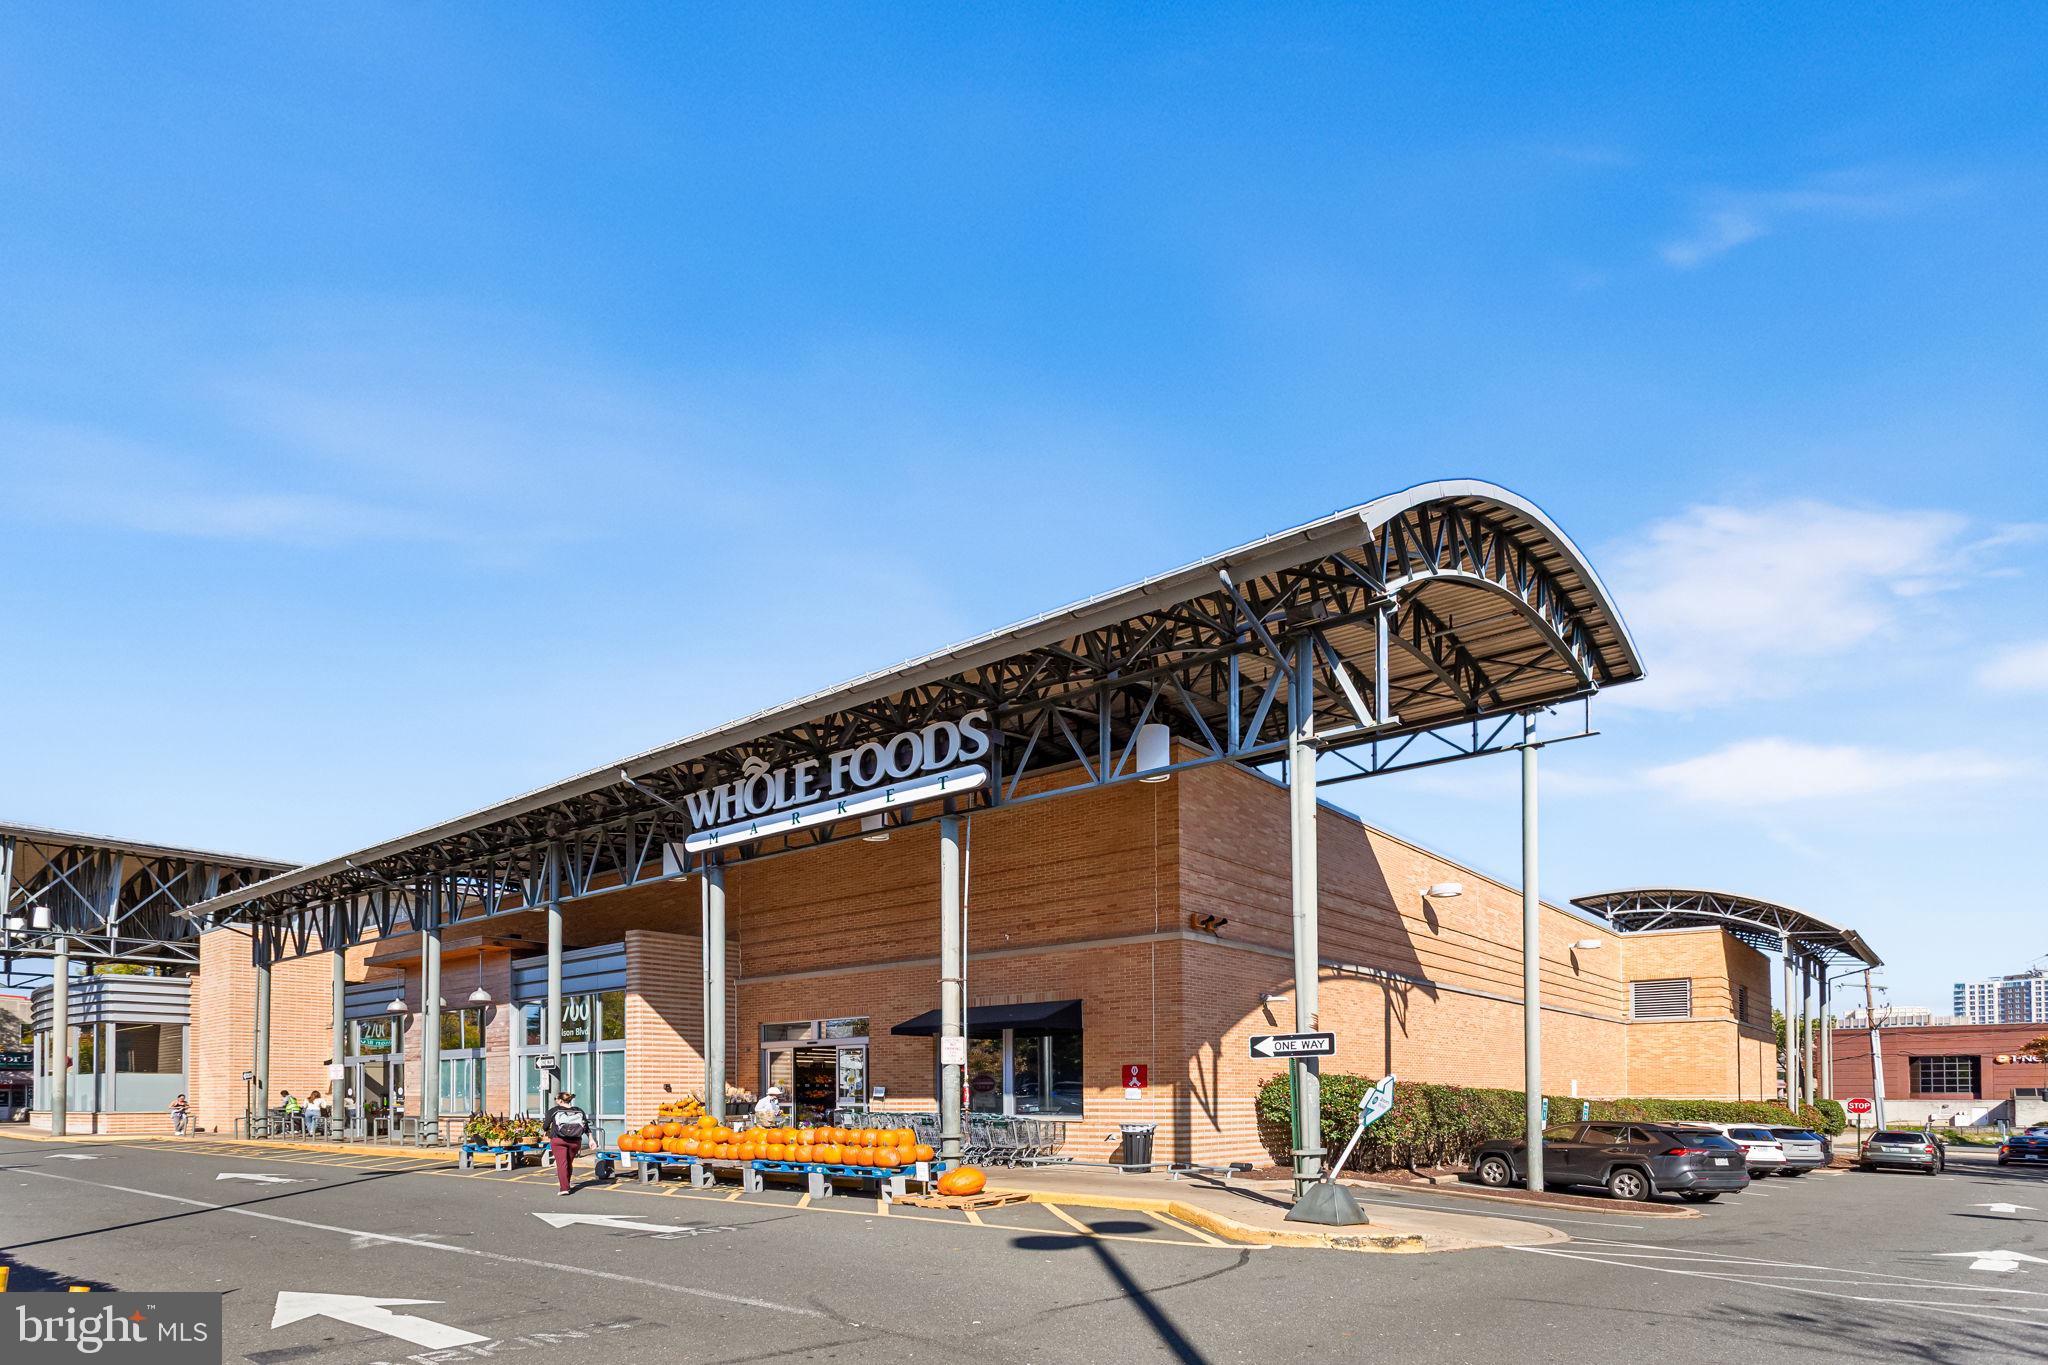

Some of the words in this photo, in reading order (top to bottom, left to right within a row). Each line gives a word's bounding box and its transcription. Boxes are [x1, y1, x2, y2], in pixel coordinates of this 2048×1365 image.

[683, 757, 821, 829] WHOLE
[828, 710, 990, 795] FOODS
[709, 775, 949, 845] MARKET
[575, 1026, 589, 1036] Blvd
[1274, 1041, 1297, 1051] ONE
[1301, 1040, 1326, 1049] WAY
